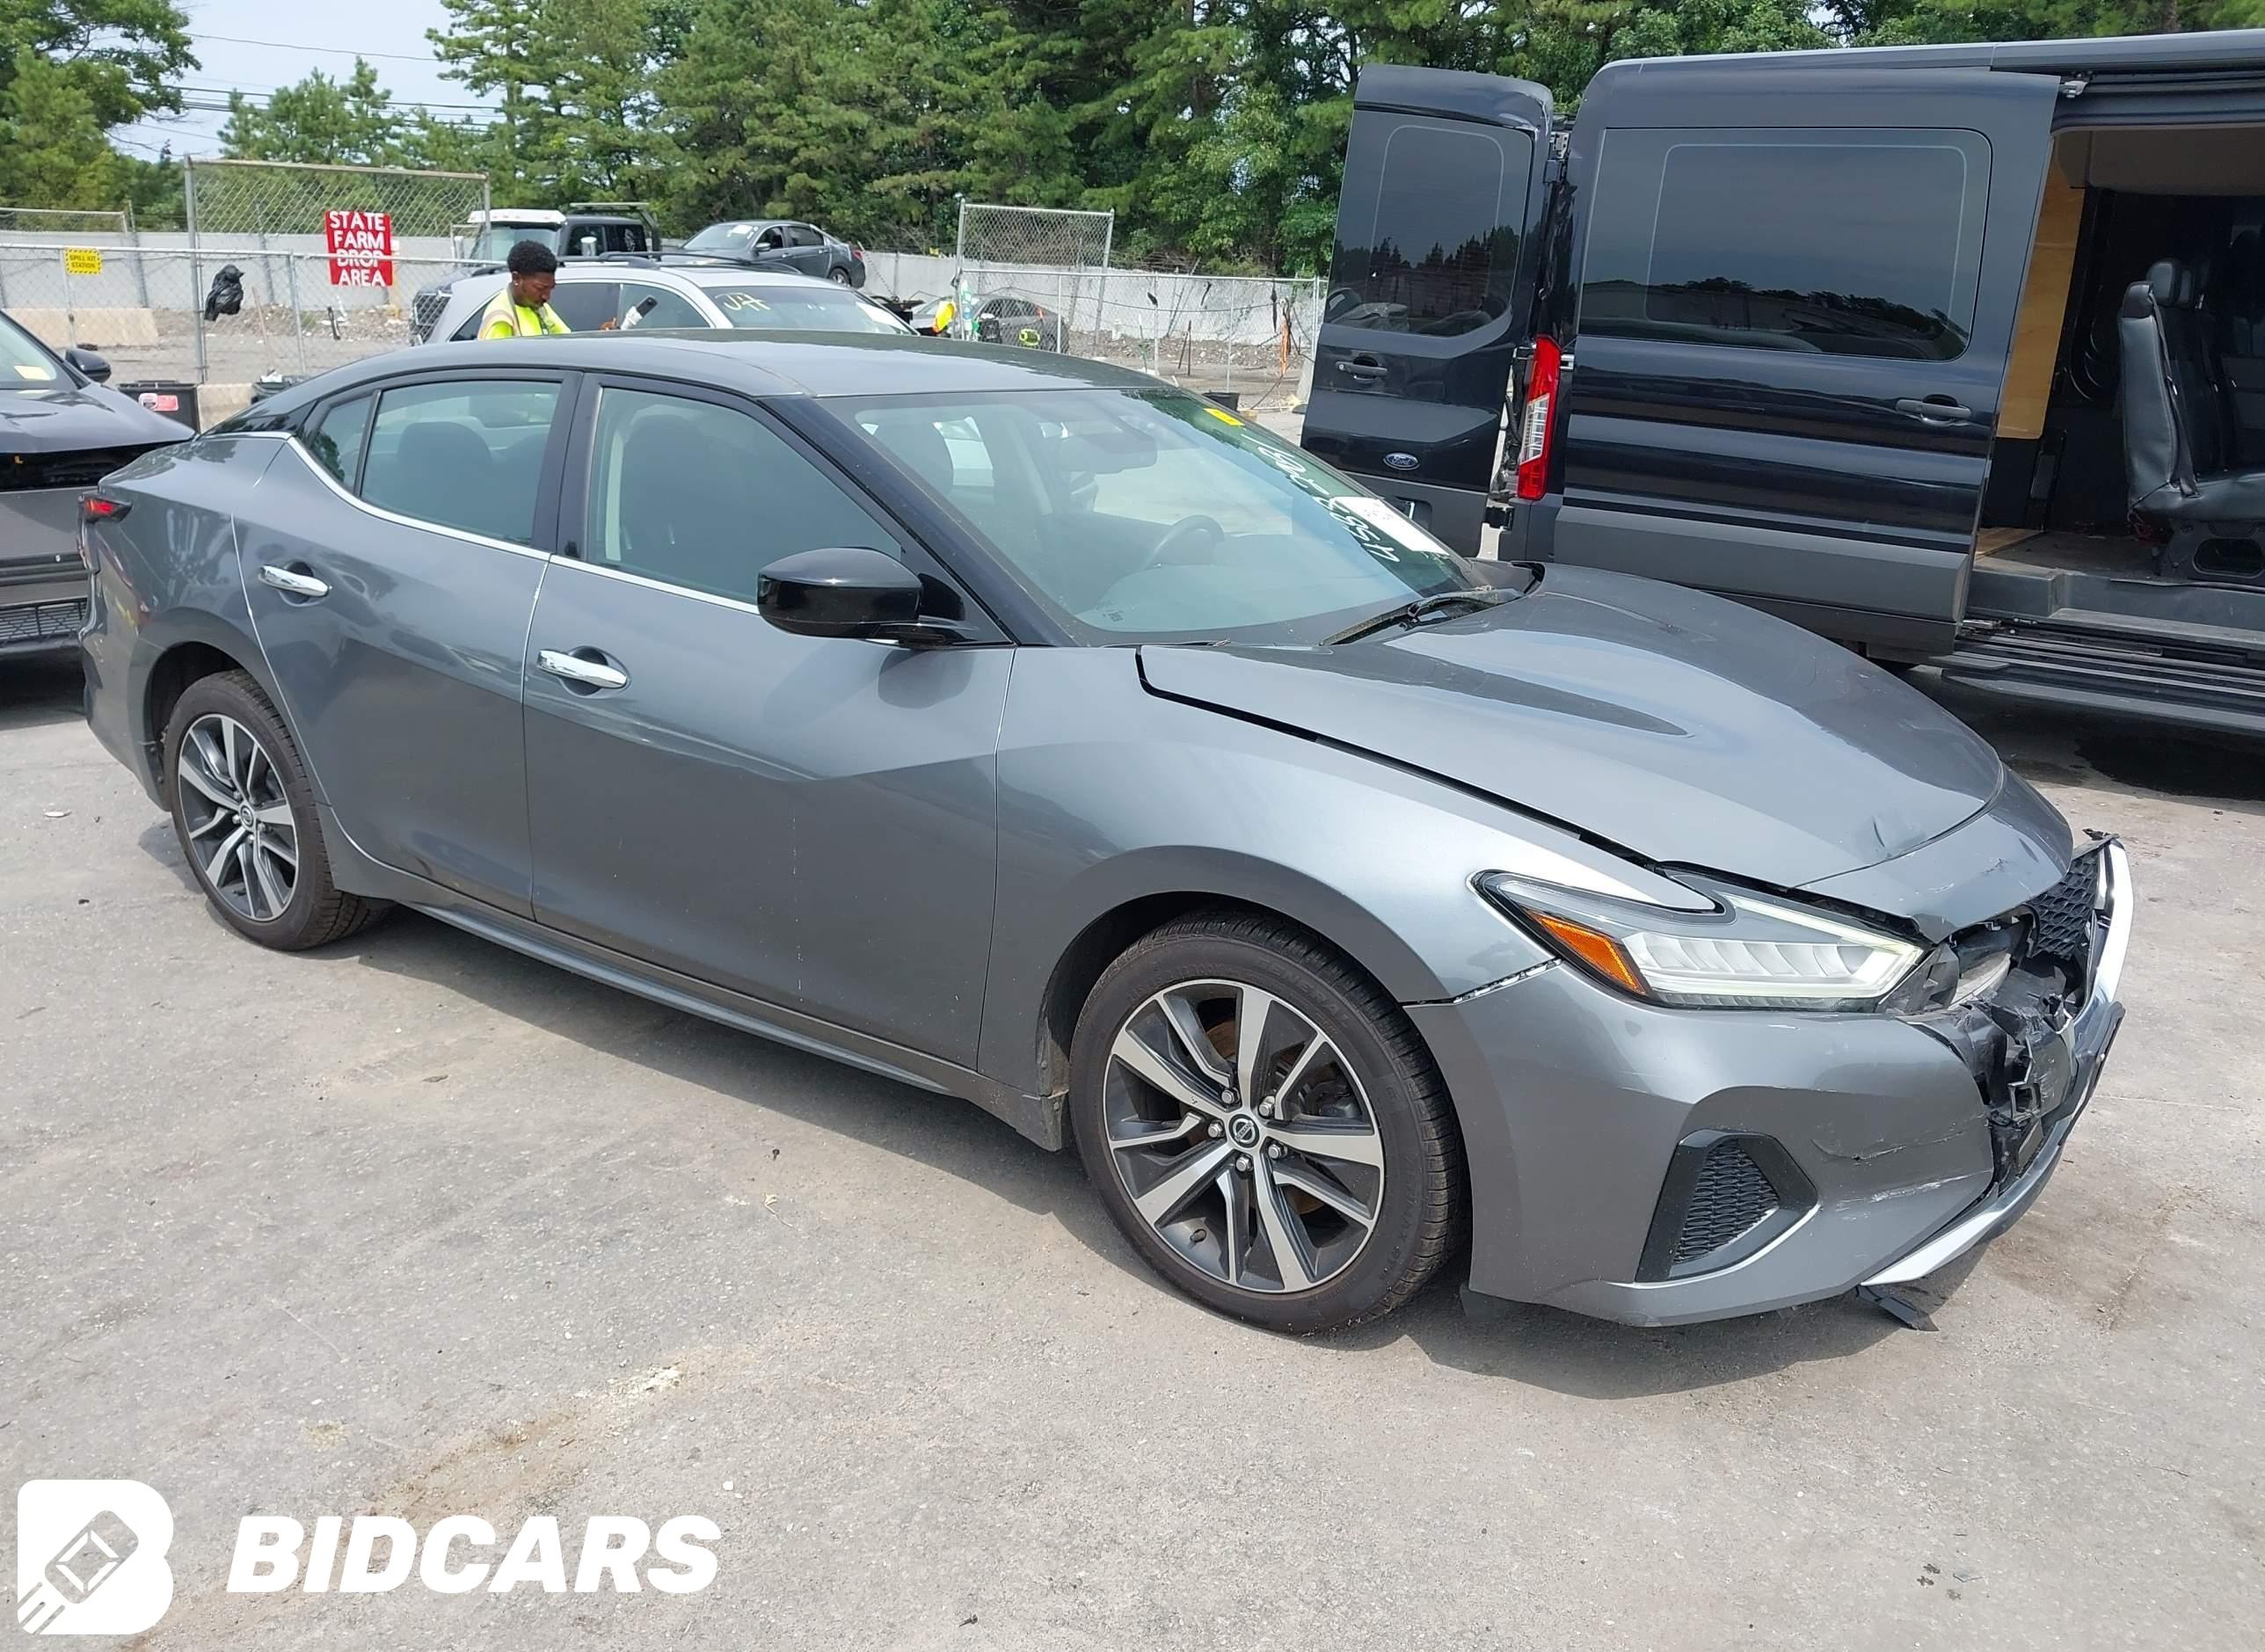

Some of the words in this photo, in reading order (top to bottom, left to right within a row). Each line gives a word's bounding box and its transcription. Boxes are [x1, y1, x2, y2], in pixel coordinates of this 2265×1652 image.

[330, 210, 385, 230] STATE
[334, 229, 384, 250] FARM
[337, 249, 383, 267] DROP
[339, 268, 386, 287] AREA
